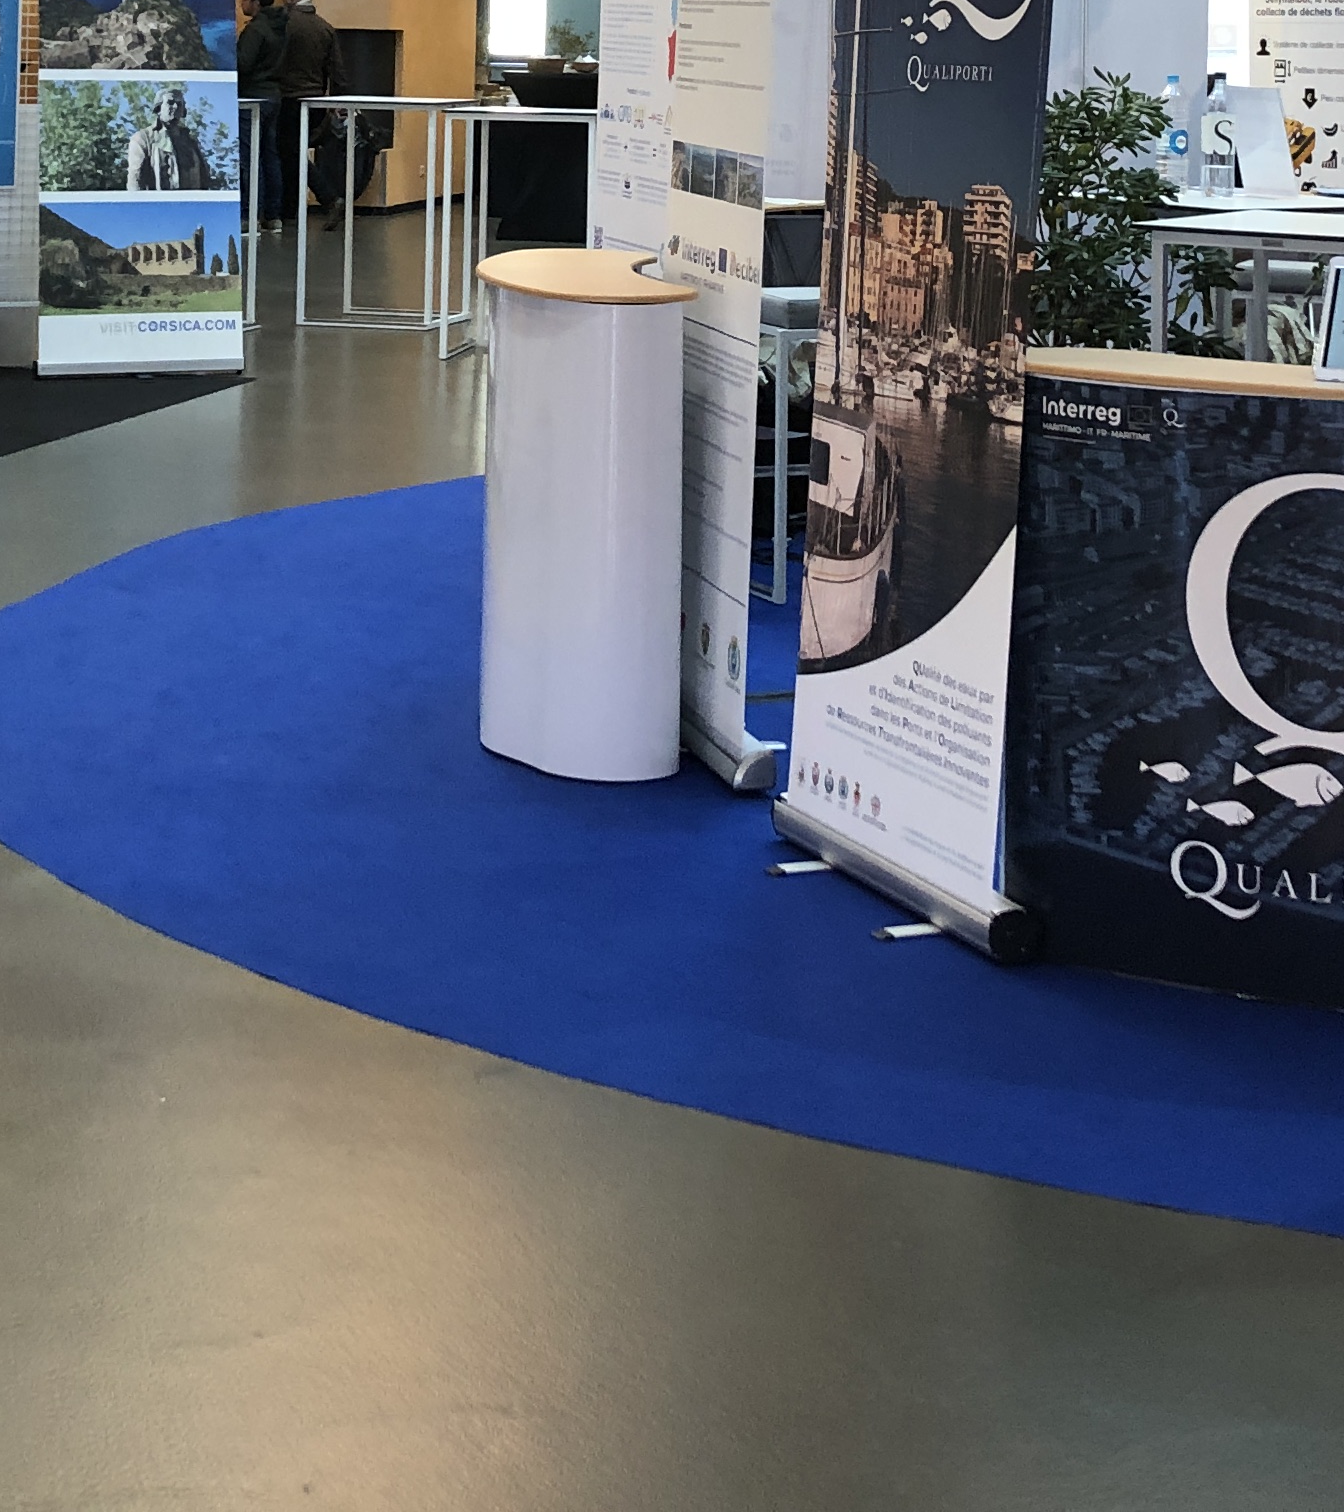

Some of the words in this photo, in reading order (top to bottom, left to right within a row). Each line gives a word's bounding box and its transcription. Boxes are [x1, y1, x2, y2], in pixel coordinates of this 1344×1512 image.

[907, 55, 993, 92] QUALIPORTI
[1213, 119, 1235, 155] S
[1042, 395, 1121, 426] Interreg
[1162, 407, 1187, 428] Q
